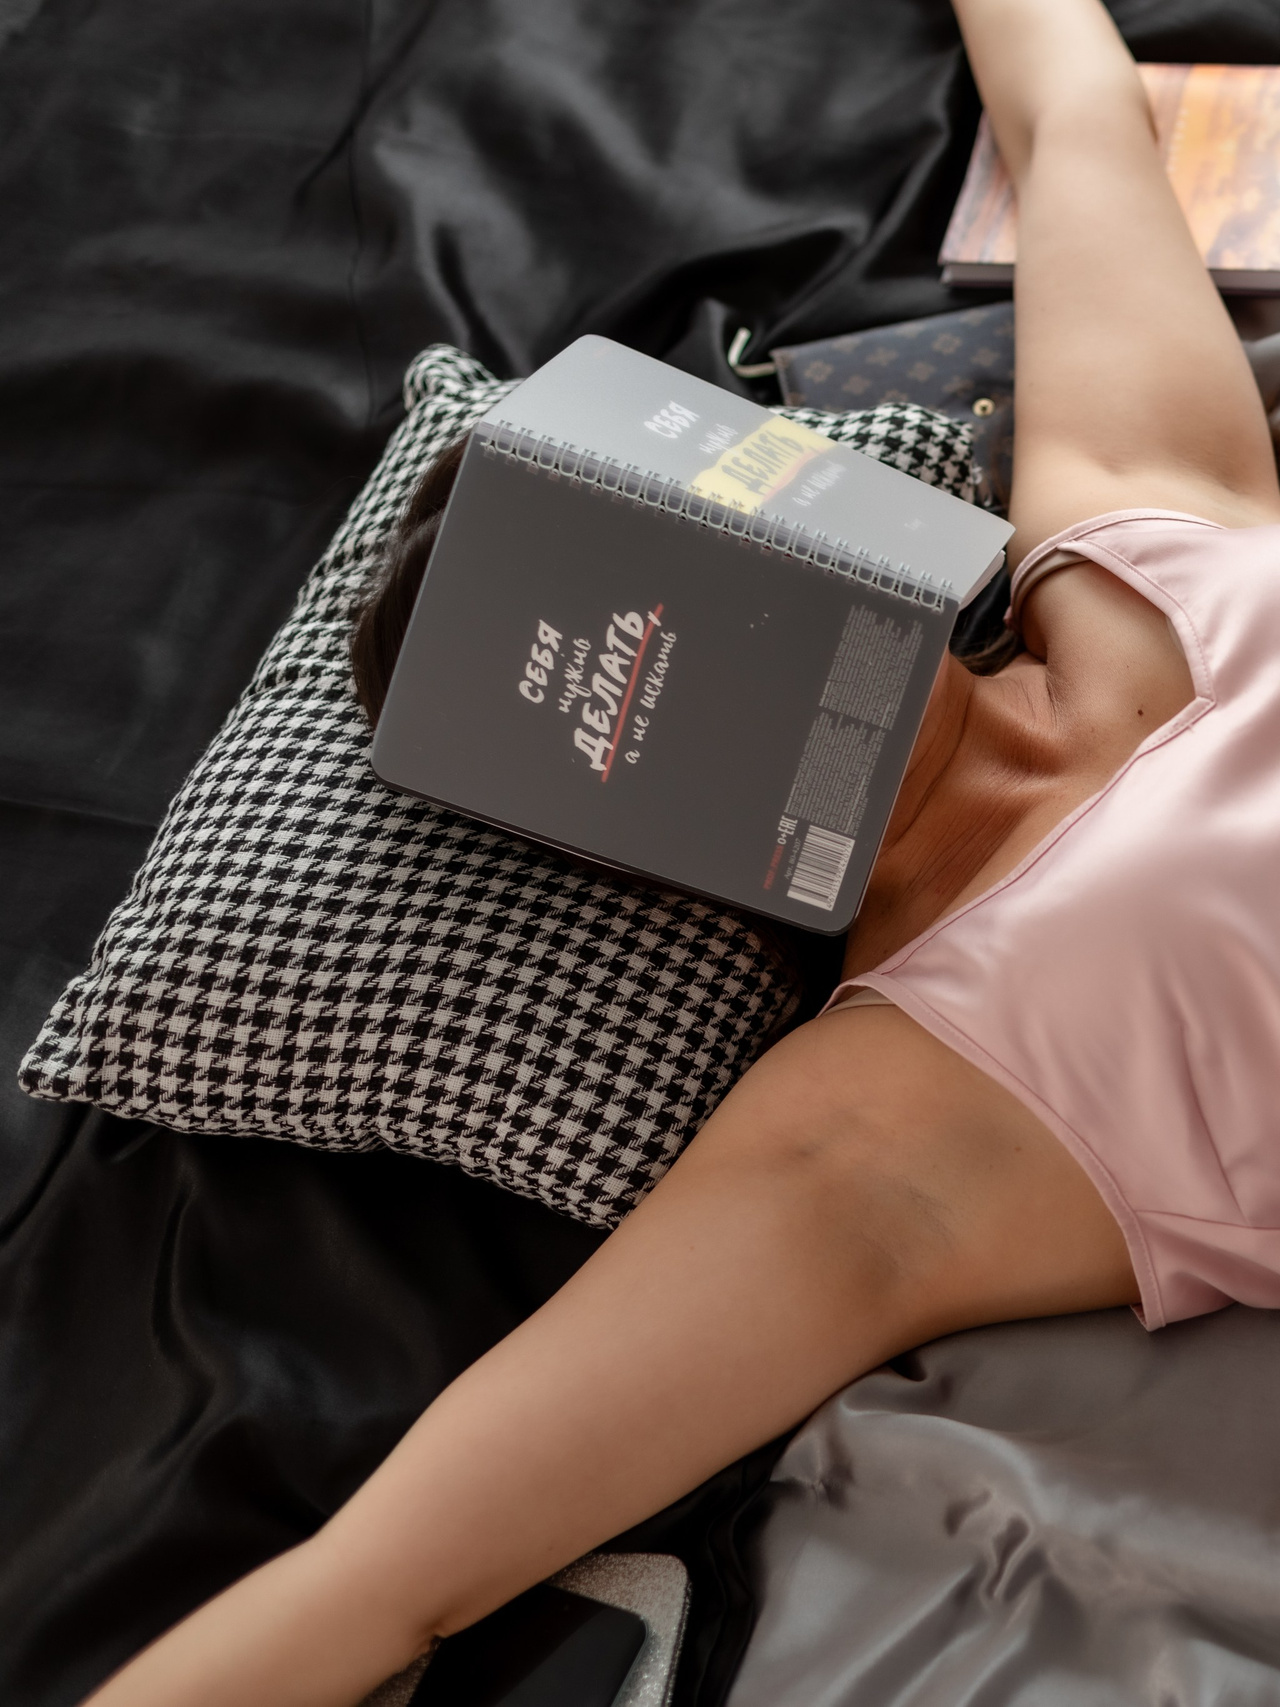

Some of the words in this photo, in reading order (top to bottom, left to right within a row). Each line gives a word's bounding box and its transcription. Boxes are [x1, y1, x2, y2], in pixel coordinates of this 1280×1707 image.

[644, 400, 700, 439] СЕБЯ
[519, 619, 563, 703] СЕБЯ
[558, 638, 592, 713] нужно
[573, 611, 662, 771] ДЕЛАТЬ,
[640, 631, 677, 709] искать
[625, 749, 641, 764] а
[633, 714, 650, 741] не
